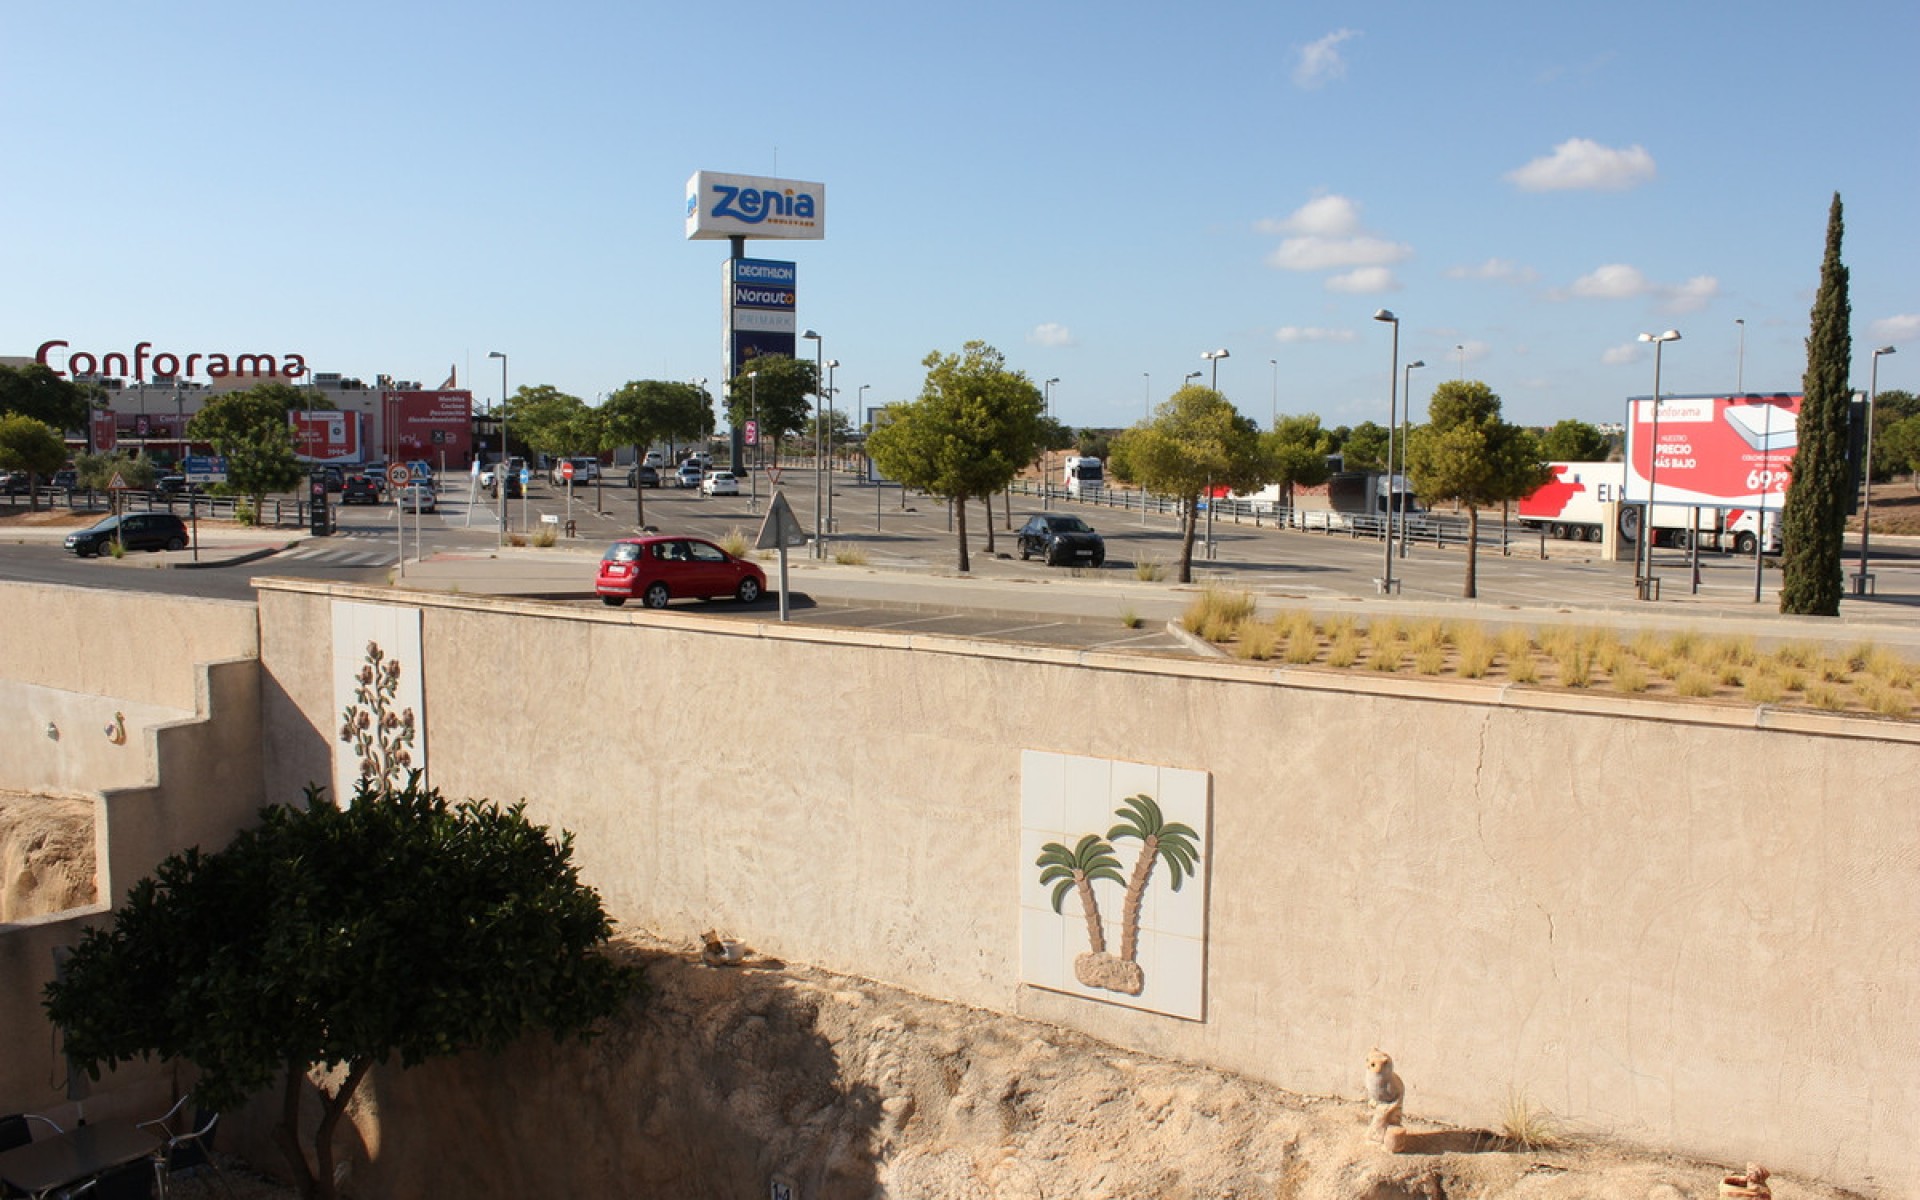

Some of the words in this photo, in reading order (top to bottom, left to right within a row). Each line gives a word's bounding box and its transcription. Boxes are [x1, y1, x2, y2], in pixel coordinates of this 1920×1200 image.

[738, 264, 793, 280] DECATHLON
[736, 287, 796, 305] Norauto
[739, 312, 793, 327] PRIMARK
[35, 340, 305, 381] Conforama
[1656, 444, 1692, 455] PRECIO
[1672, 458, 1697, 469] BAJO
[393, 471, 407, 479] 20
[1597, 483, 1616, 502] EL
